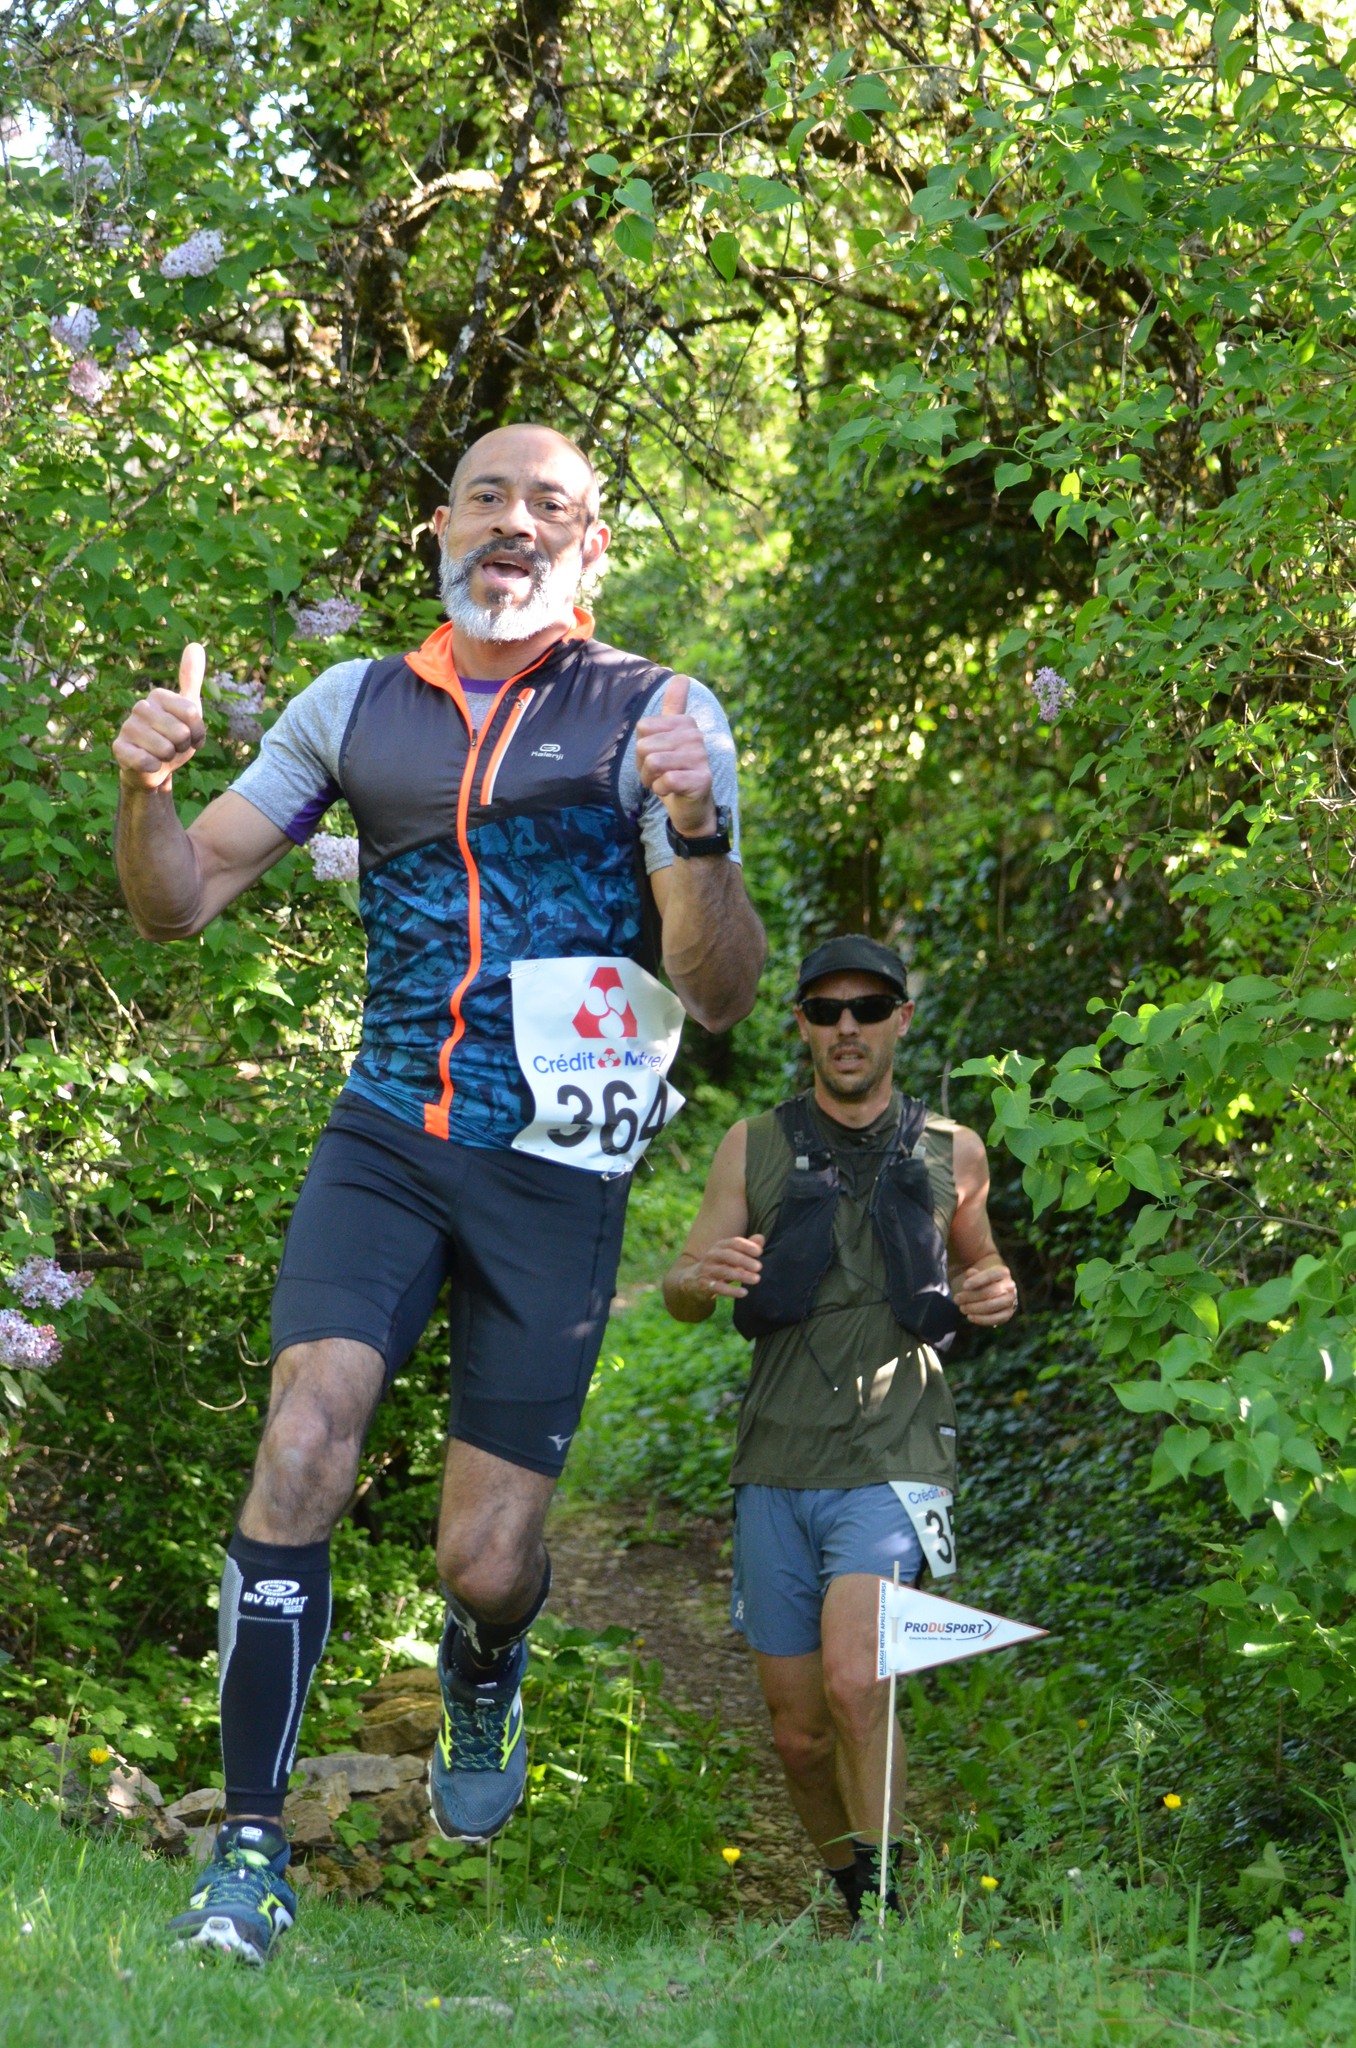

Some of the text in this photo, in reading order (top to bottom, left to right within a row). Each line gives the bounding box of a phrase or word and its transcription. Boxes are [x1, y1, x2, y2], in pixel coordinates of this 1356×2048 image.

[533, 1052, 595, 1074] Crédit
[547, 1080, 668, 1156] 364
[908, 1488, 940, 1505] Crédit
[265, 1596, 308, 1606] SPORT
